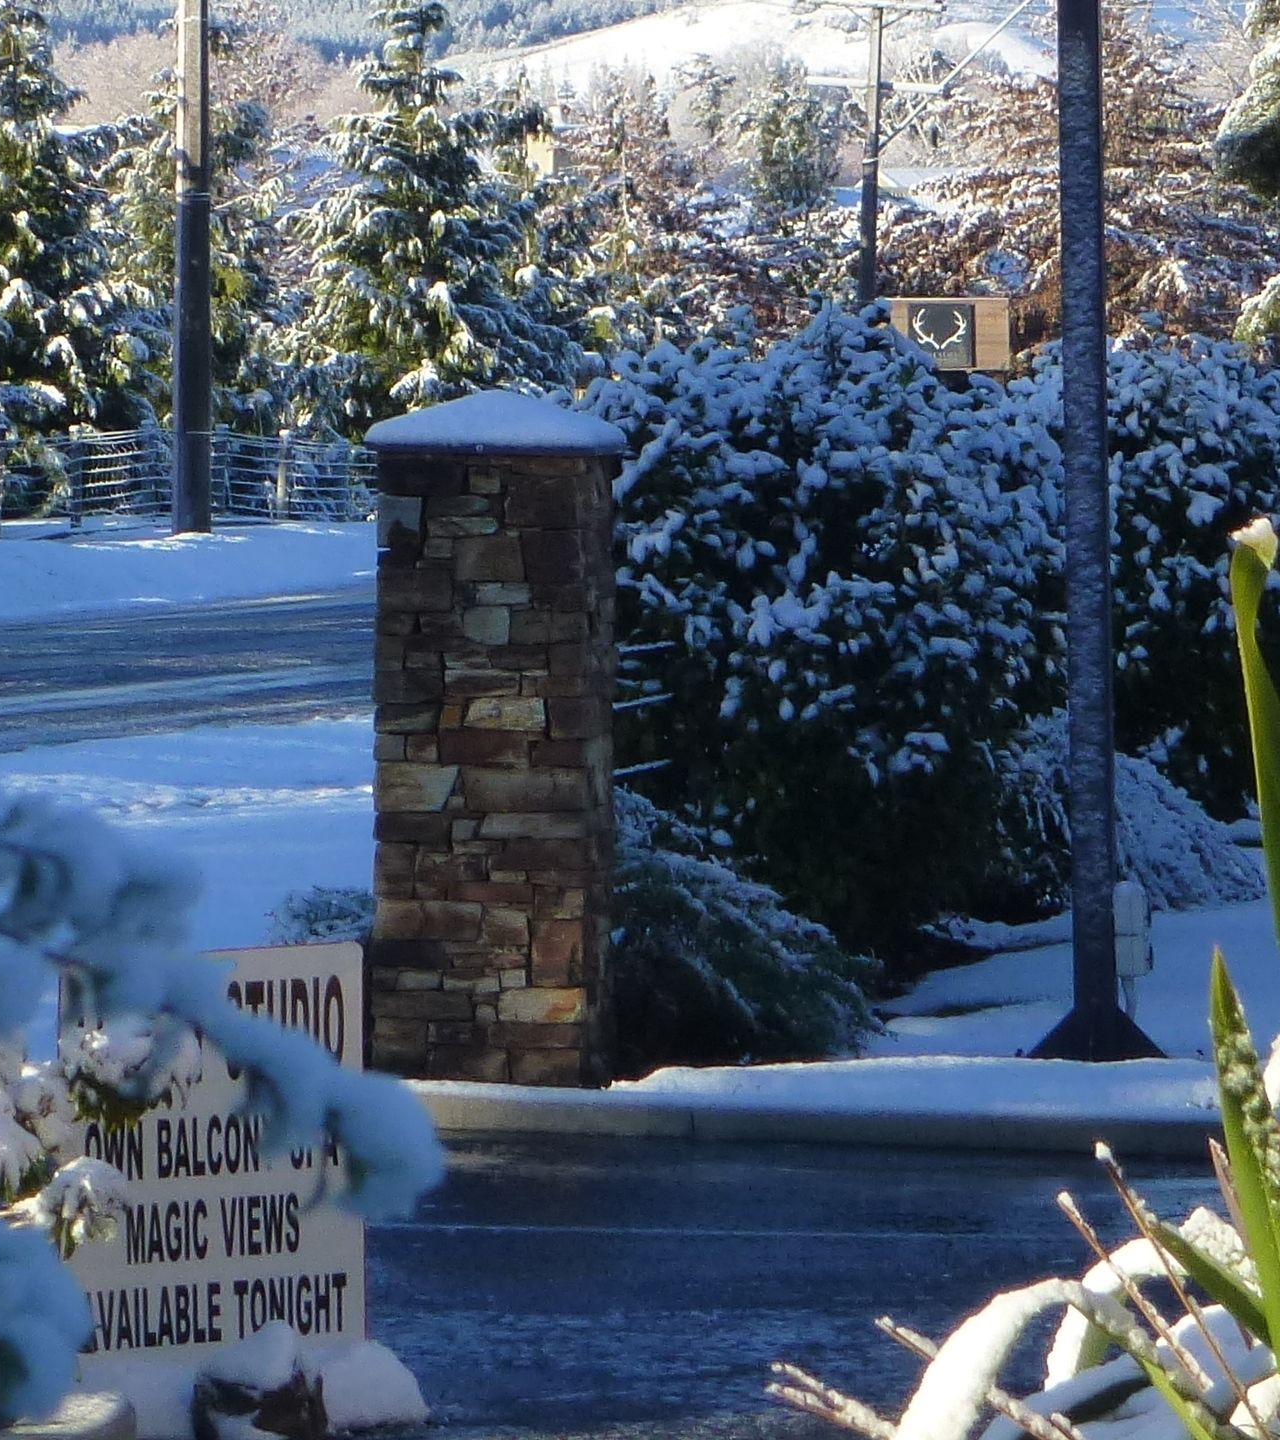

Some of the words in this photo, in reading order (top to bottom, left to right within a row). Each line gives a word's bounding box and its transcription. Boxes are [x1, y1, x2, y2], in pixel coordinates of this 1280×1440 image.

[156, 1113, 262, 1180] BALCON
[125, 1198, 210, 1266] MAGIC
[219, 1191, 301, 1258] VIEWS
[232, 1271, 348, 1342] TONIGHT
